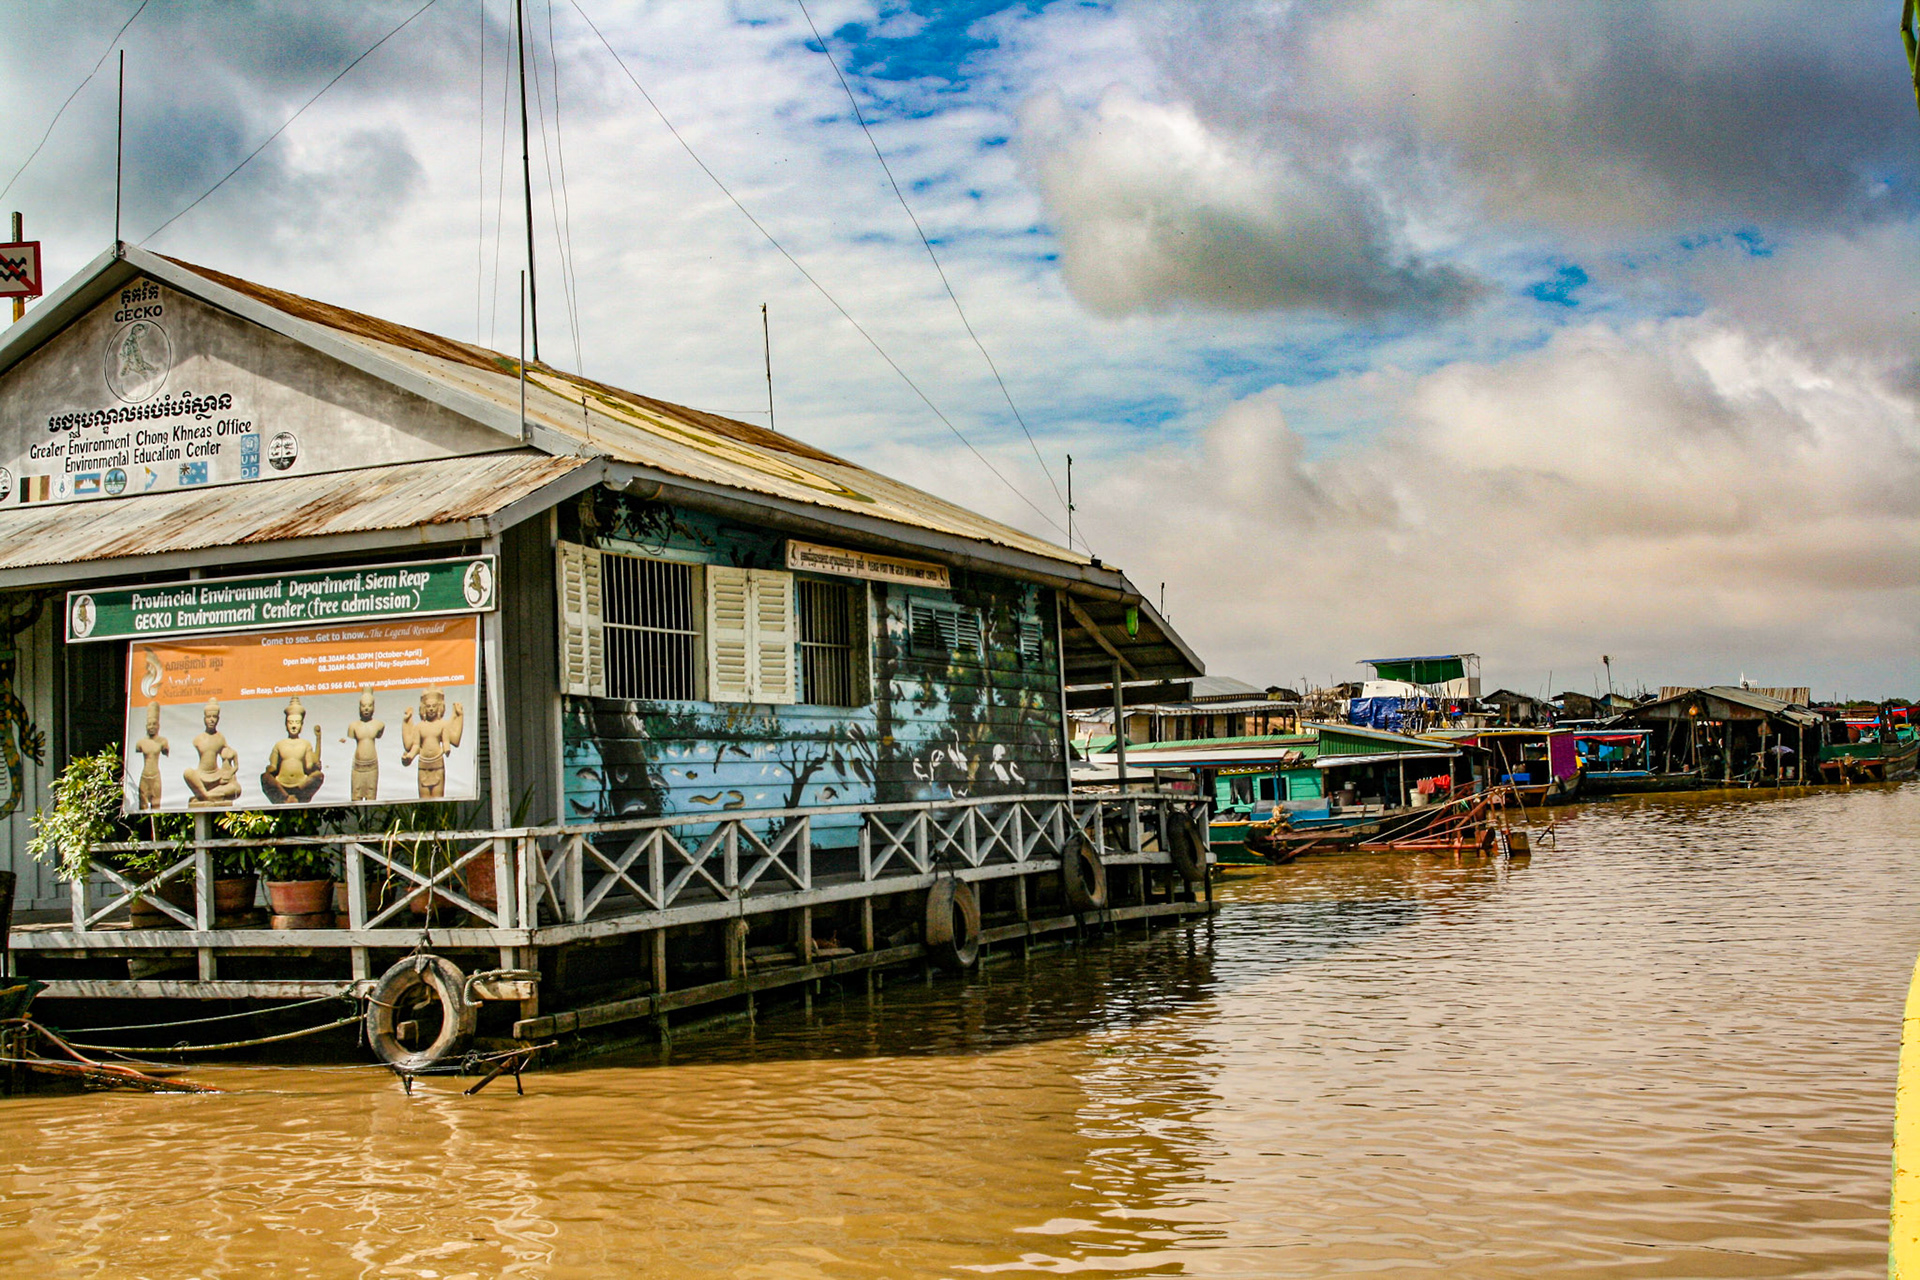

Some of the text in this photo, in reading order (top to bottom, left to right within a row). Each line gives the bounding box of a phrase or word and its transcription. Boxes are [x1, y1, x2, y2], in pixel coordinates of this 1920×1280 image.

[114, 305, 162, 322] GECKO
[30, 419, 252, 459] Greater Environment Chong Khneas Office
[65, 440, 221, 473] Environmental Education Center
[132, 587, 197, 611] Provincial
[200, 580, 282, 604] Environment
[399, 570, 430, 591] Reap
[135, 612, 172, 630] GECKO
[177, 603, 257, 626] Environment
[261, 637, 283, 647] Come
[285, 636, 294, 644] to
[331, 632, 340, 641] to
[384, 625, 411, 639] Legend
[412, 622, 446, 636] Revealed
[283, 658, 299, 667] Open
[300, 657, 317, 665] Daily:
[375, 648, 422, 660] [October-April]
[375, 657, 430, 670] [May-September]
[256, 687, 273, 695] Reap,
[331, 682, 342, 690] 966
[358, 674, 465, 688] www.angkornationalmuseum.com
